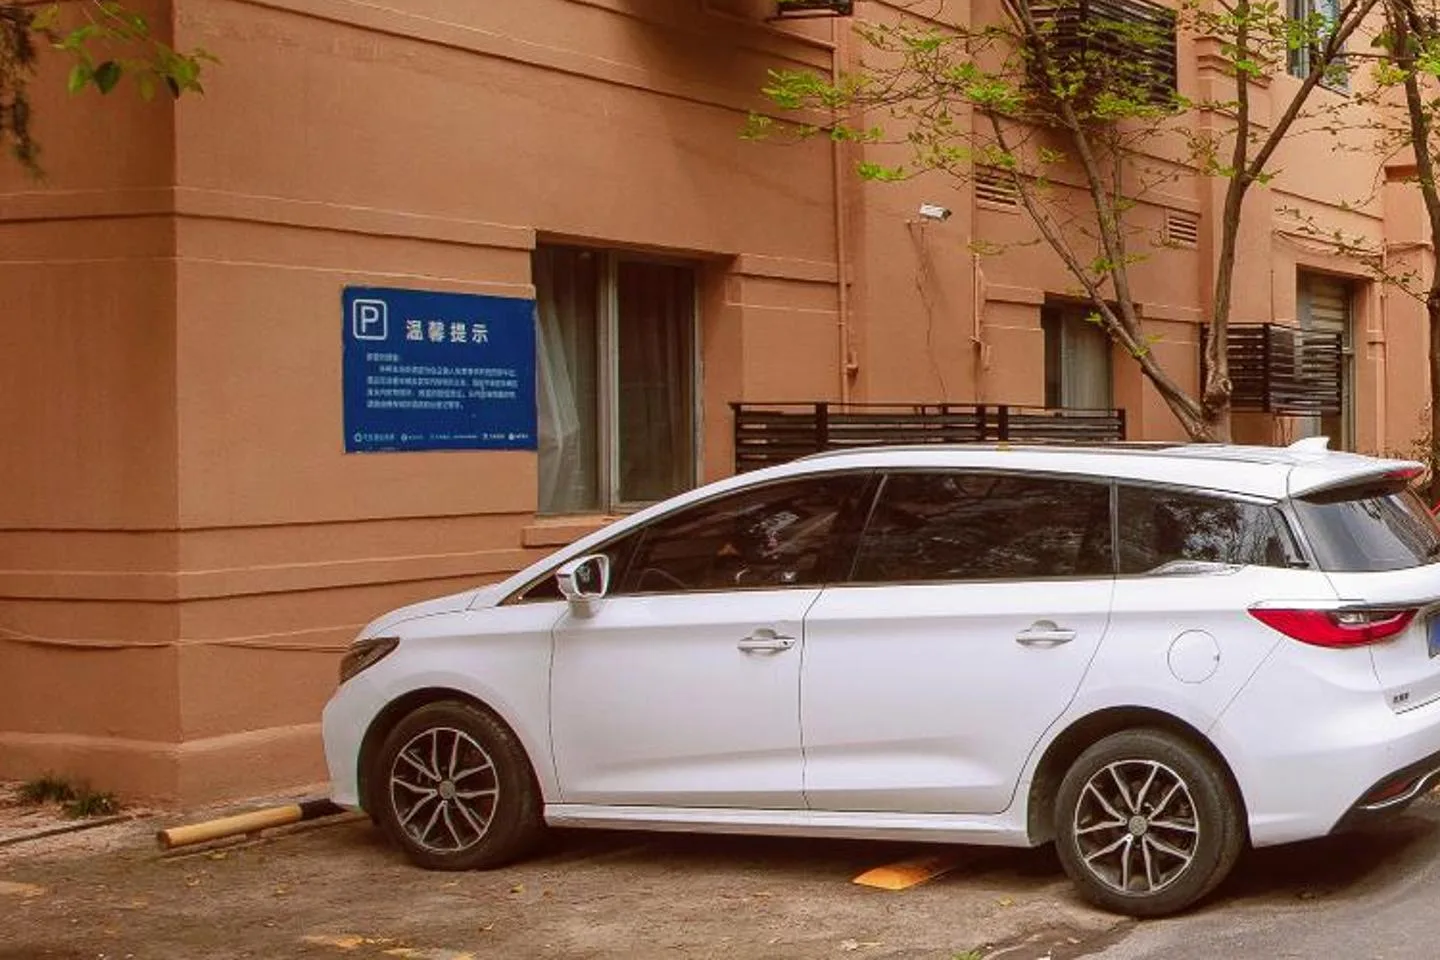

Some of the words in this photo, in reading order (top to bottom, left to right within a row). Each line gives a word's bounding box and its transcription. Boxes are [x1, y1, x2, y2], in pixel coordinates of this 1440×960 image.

[361, 305, 379, 333] P
[405, 319, 489, 344] 温馨提示
